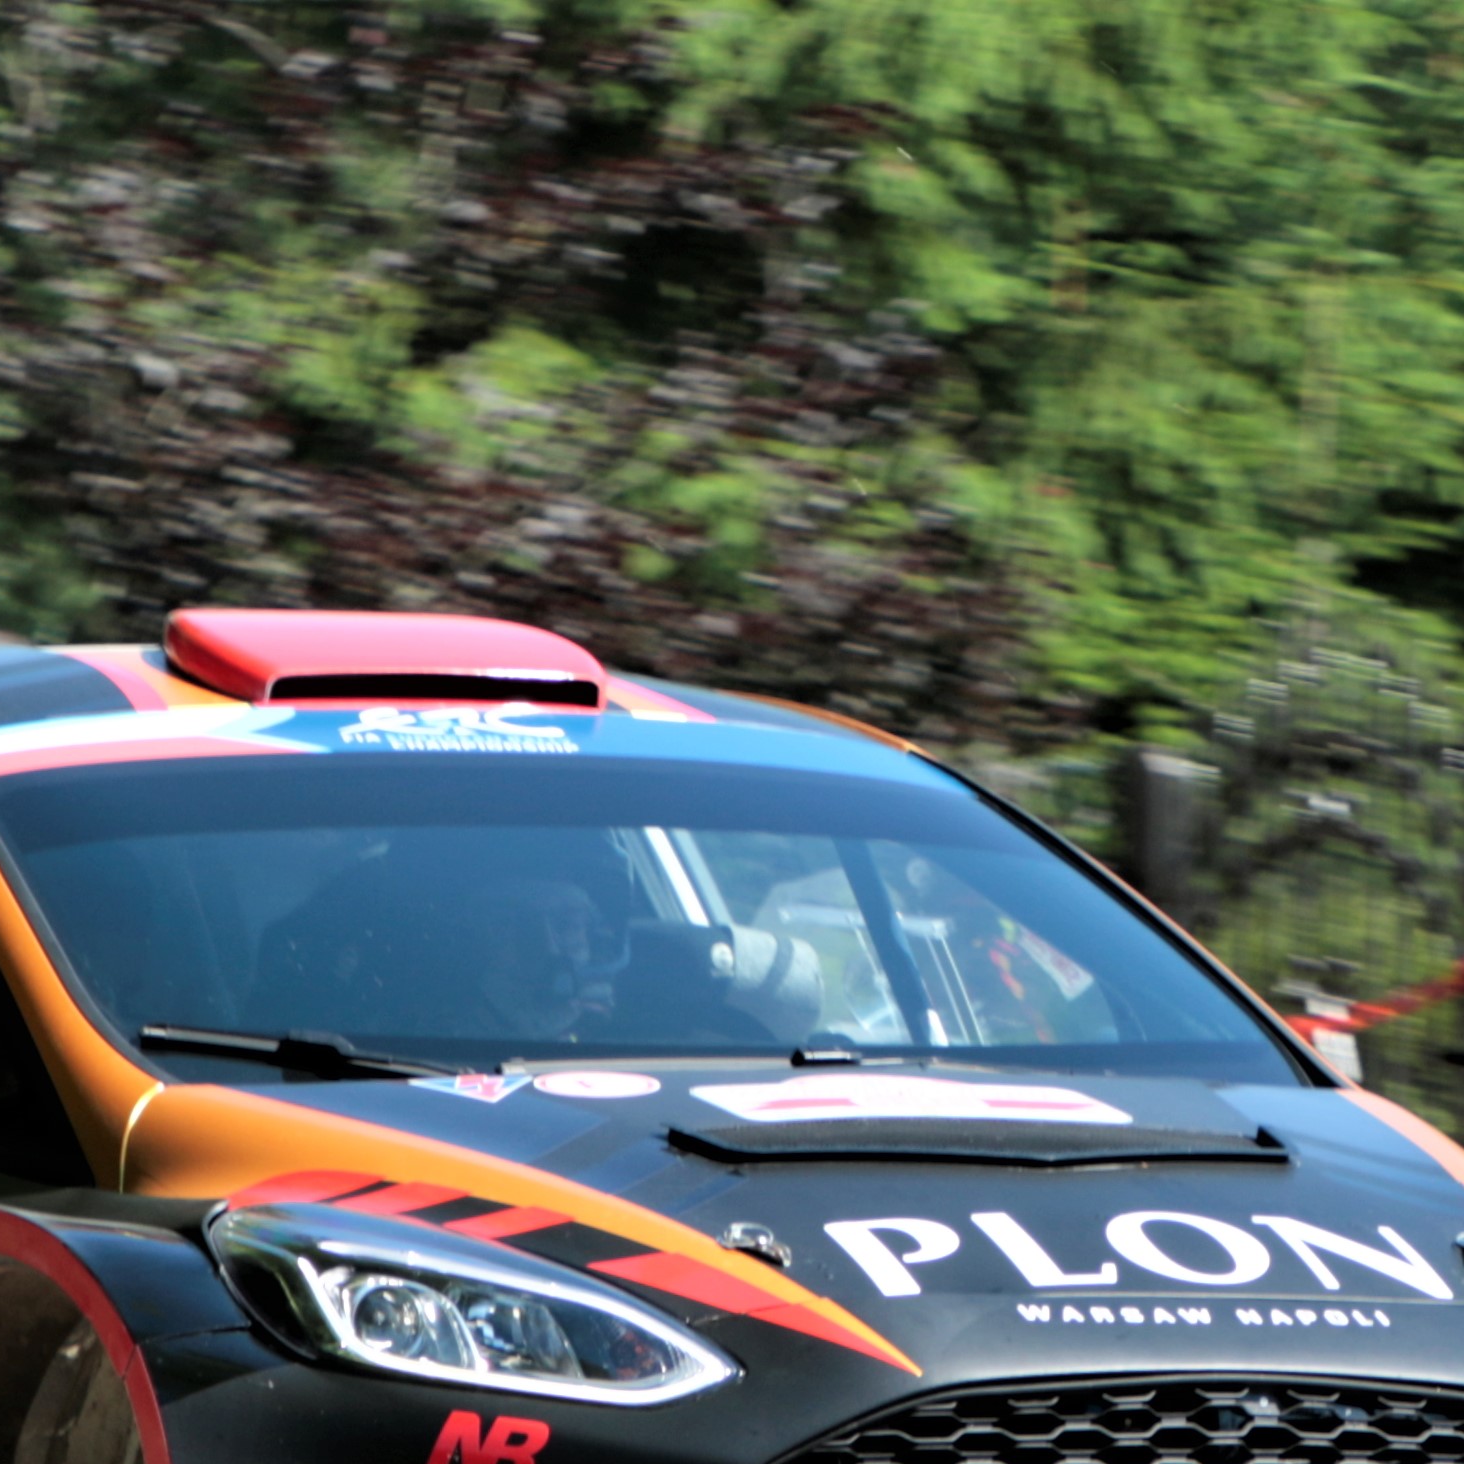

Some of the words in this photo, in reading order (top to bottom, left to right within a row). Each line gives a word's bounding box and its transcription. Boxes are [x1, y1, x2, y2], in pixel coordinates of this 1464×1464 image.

[823, 1210, 1454, 1300] PLON
[1015, 1302, 1213, 1326] WARSAW
[1235, 1305, 1391, 1328] NAPOLI
